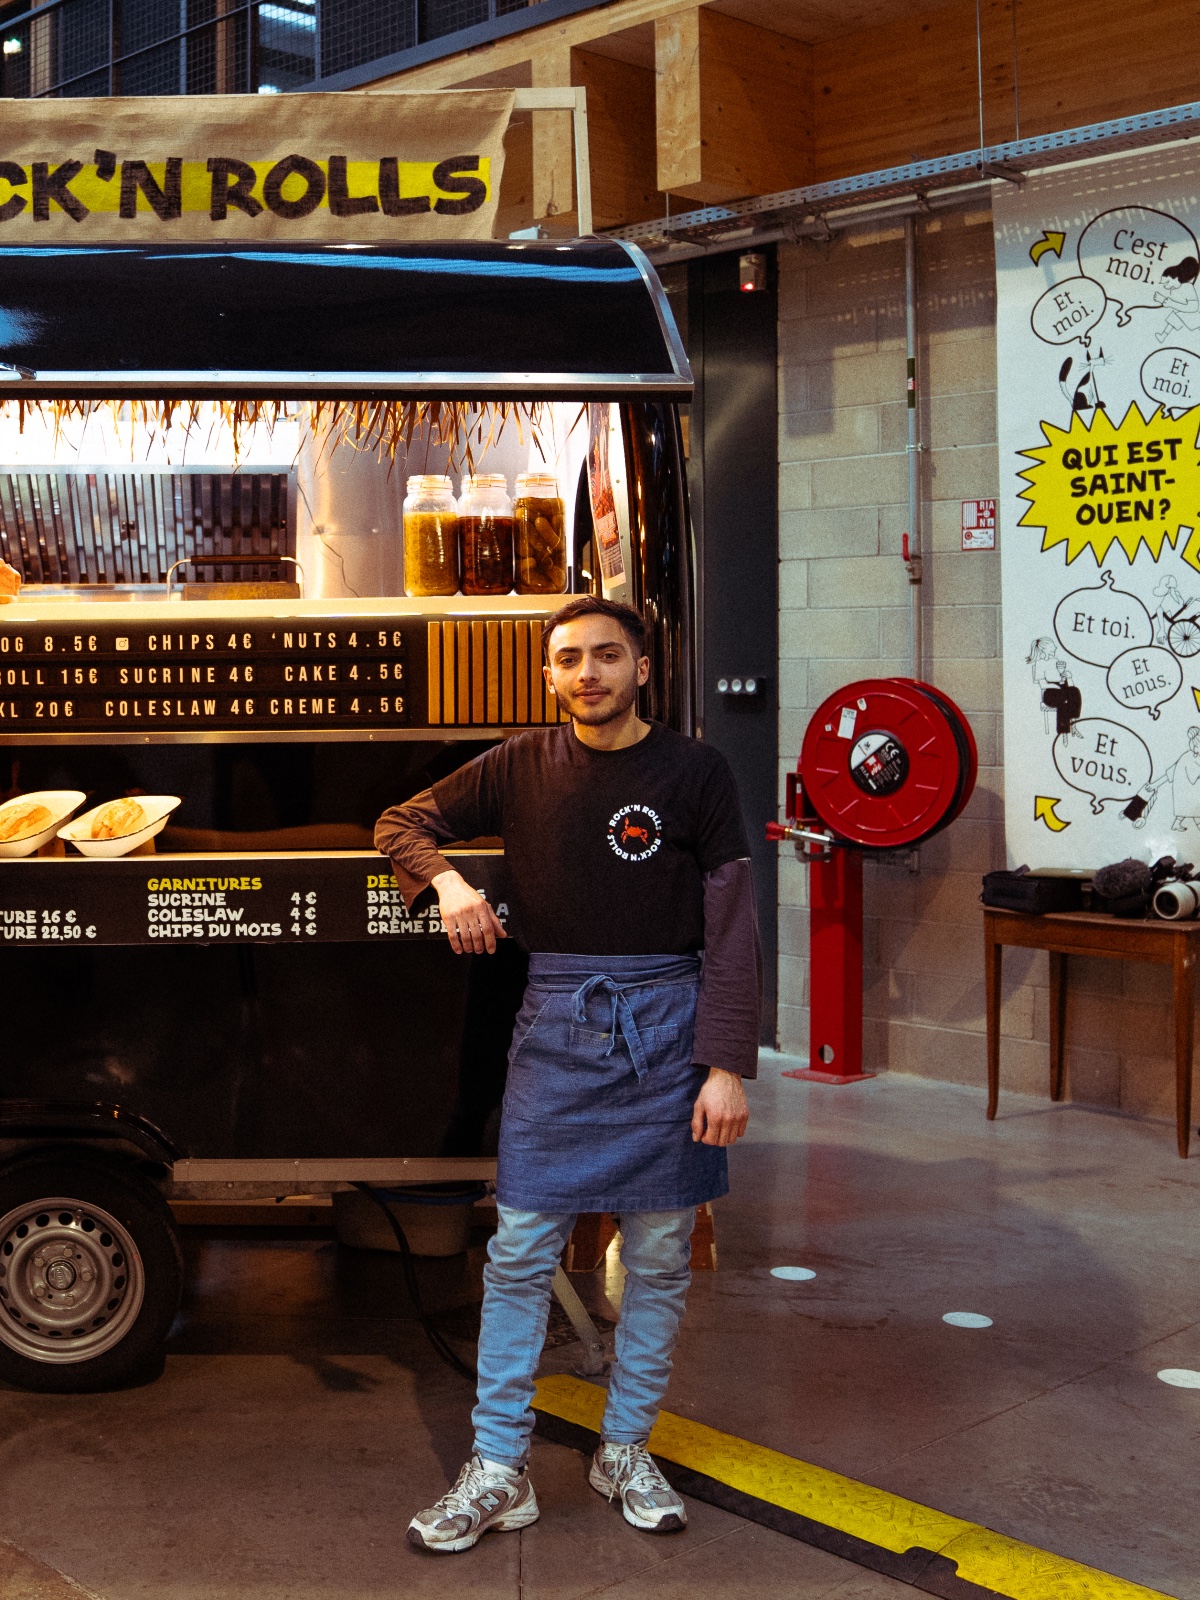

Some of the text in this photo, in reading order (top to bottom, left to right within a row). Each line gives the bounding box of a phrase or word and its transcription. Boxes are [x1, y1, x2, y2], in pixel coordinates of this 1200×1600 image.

[206, 154, 487, 221] ROLLS
[1113, 228, 1169, 262] C'est
[1105, 255, 1155, 285] moi.
[1053, 290, 1074, 313] Et
[1052, 301, 1095, 336] moi.
[1169, 357, 1190, 378] Et
[1152, 375, 1192, 399] moi.
[1062, 438, 1183, 471] QUI EST
[1069, 470, 1176, 498] SAINT-
[980, 501, 995, 510] RIA
[1076, 498, 1171, 526] OUEN?
[1072, 612, 1136, 639] Et toi.
[44, 635, 97, 652] 8.5€
[148, 634, 215, 651] CHIPS
[227, 633, 252, 650] 4€
[348, 631, 402, 648] 4.5€
[61, 668, 98, 685] 15€
[119, 667, 215, 684] SUCRINE
[229, 666, 253, 683] 4€
[284, 665, 337, 682] CAKE
[349, 664, 403, 681] 4.5€
[1131, 657, 1151, 677] Et
[1122, 673, 1172, 700] nous.
[35, 701, 73, 718] 20€
[105, 700, 216, 717] COLESLAW
[230, 699, 254, 715] 4€
[270, 699, 336, 715] CREME
[350, 696, 404, 714] 4.5€
[1094, 732, 1119, 757] Et
[1070, 754, 1133, 787] vous.
[608, 804, 662, 831] ROCK'N ROLLS
[606, 834, 661, 861] ROCK'N ROLLS
[147, 877, 263, 892] GARNITURES
[367, 875, 399, 889] DES
[147, 892, 317, 907] SUCRINE 4 €
[367, 890, 405, 904] BRI
[41, 909, 61, 923] 16
[65, 909, 77, 923] €
[147, 907, 317, 923] COLESLAW 4 €
[41, 925, 82, 941] 22,50
[85, 925, 97, 939] €
[147, 922, 317, 938] CHIPS DU MOIS 4 €
